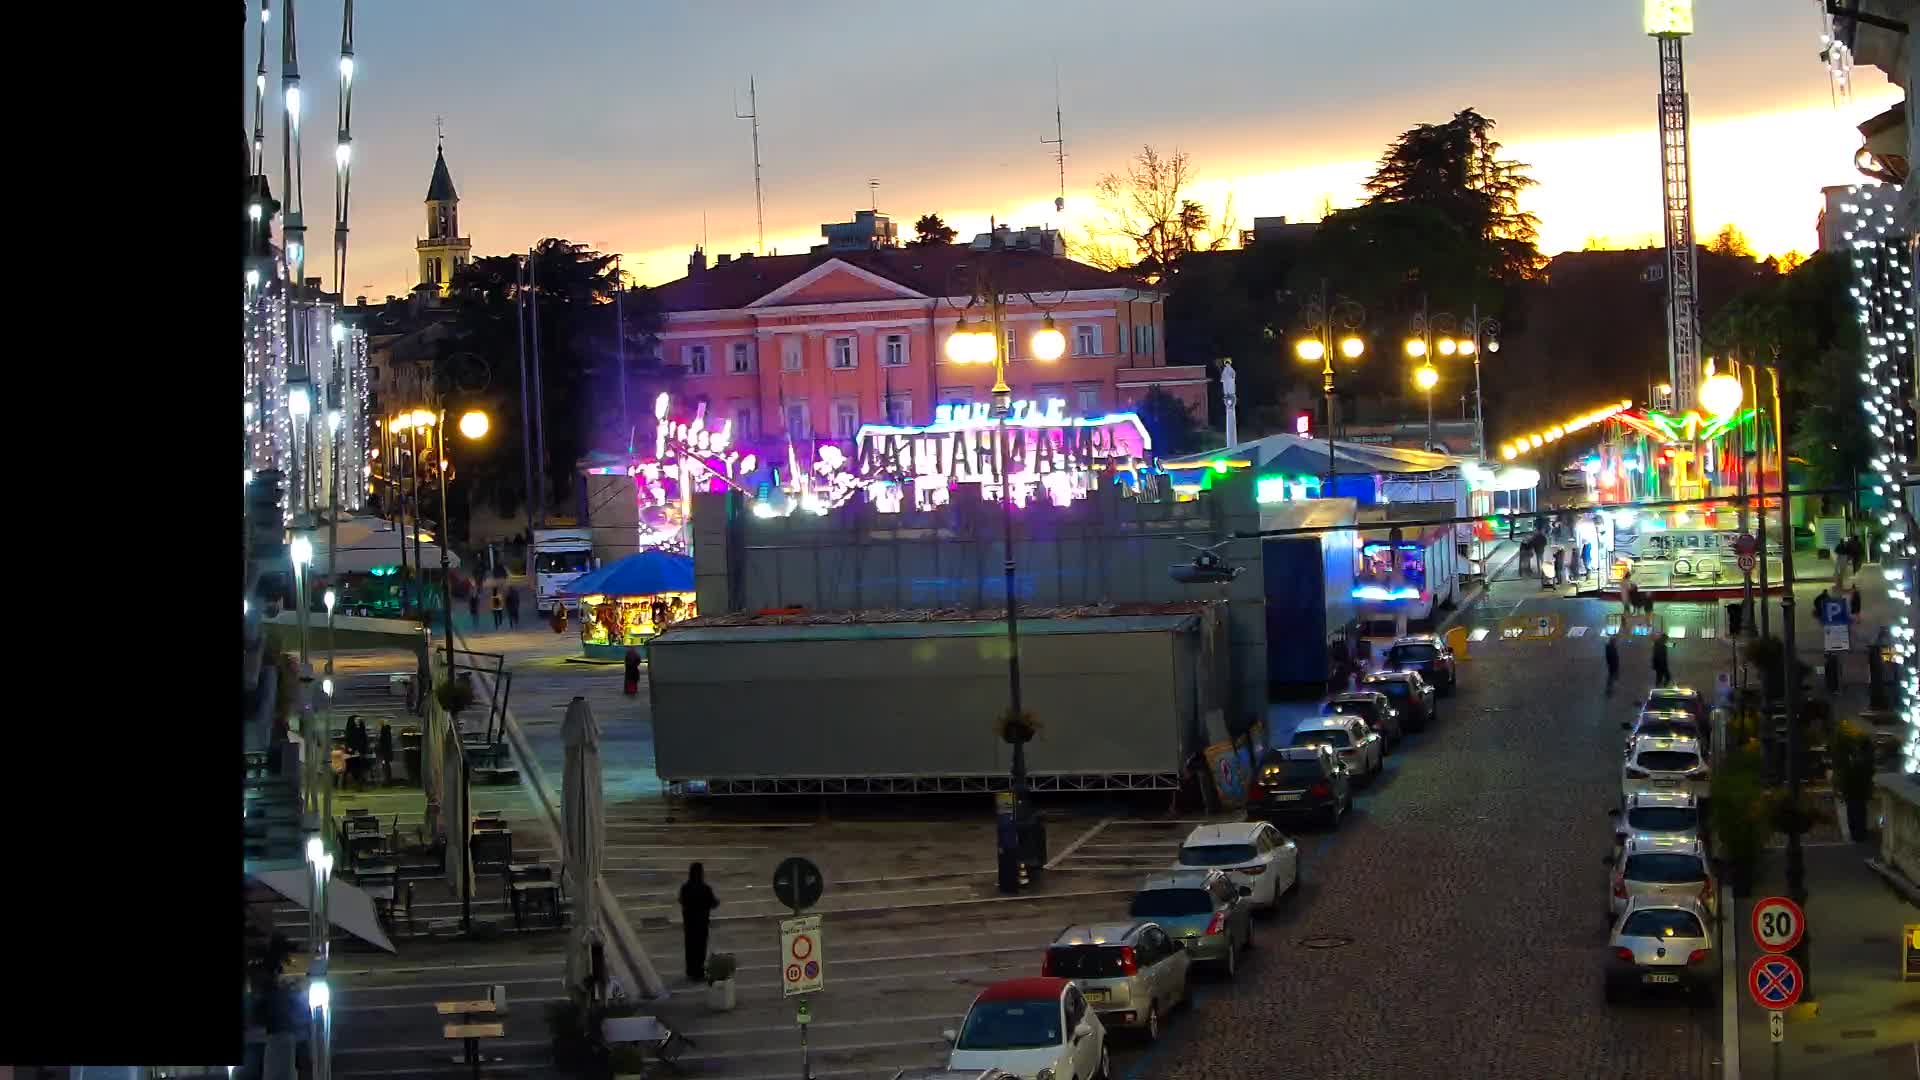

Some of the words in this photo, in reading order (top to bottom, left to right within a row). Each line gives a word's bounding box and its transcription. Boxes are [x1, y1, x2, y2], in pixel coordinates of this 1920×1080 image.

[935, 398, 1066, 423] SHUTLE
[1826, 602, 1842, 622] P
[1762, 911, 1792, 938] 30
